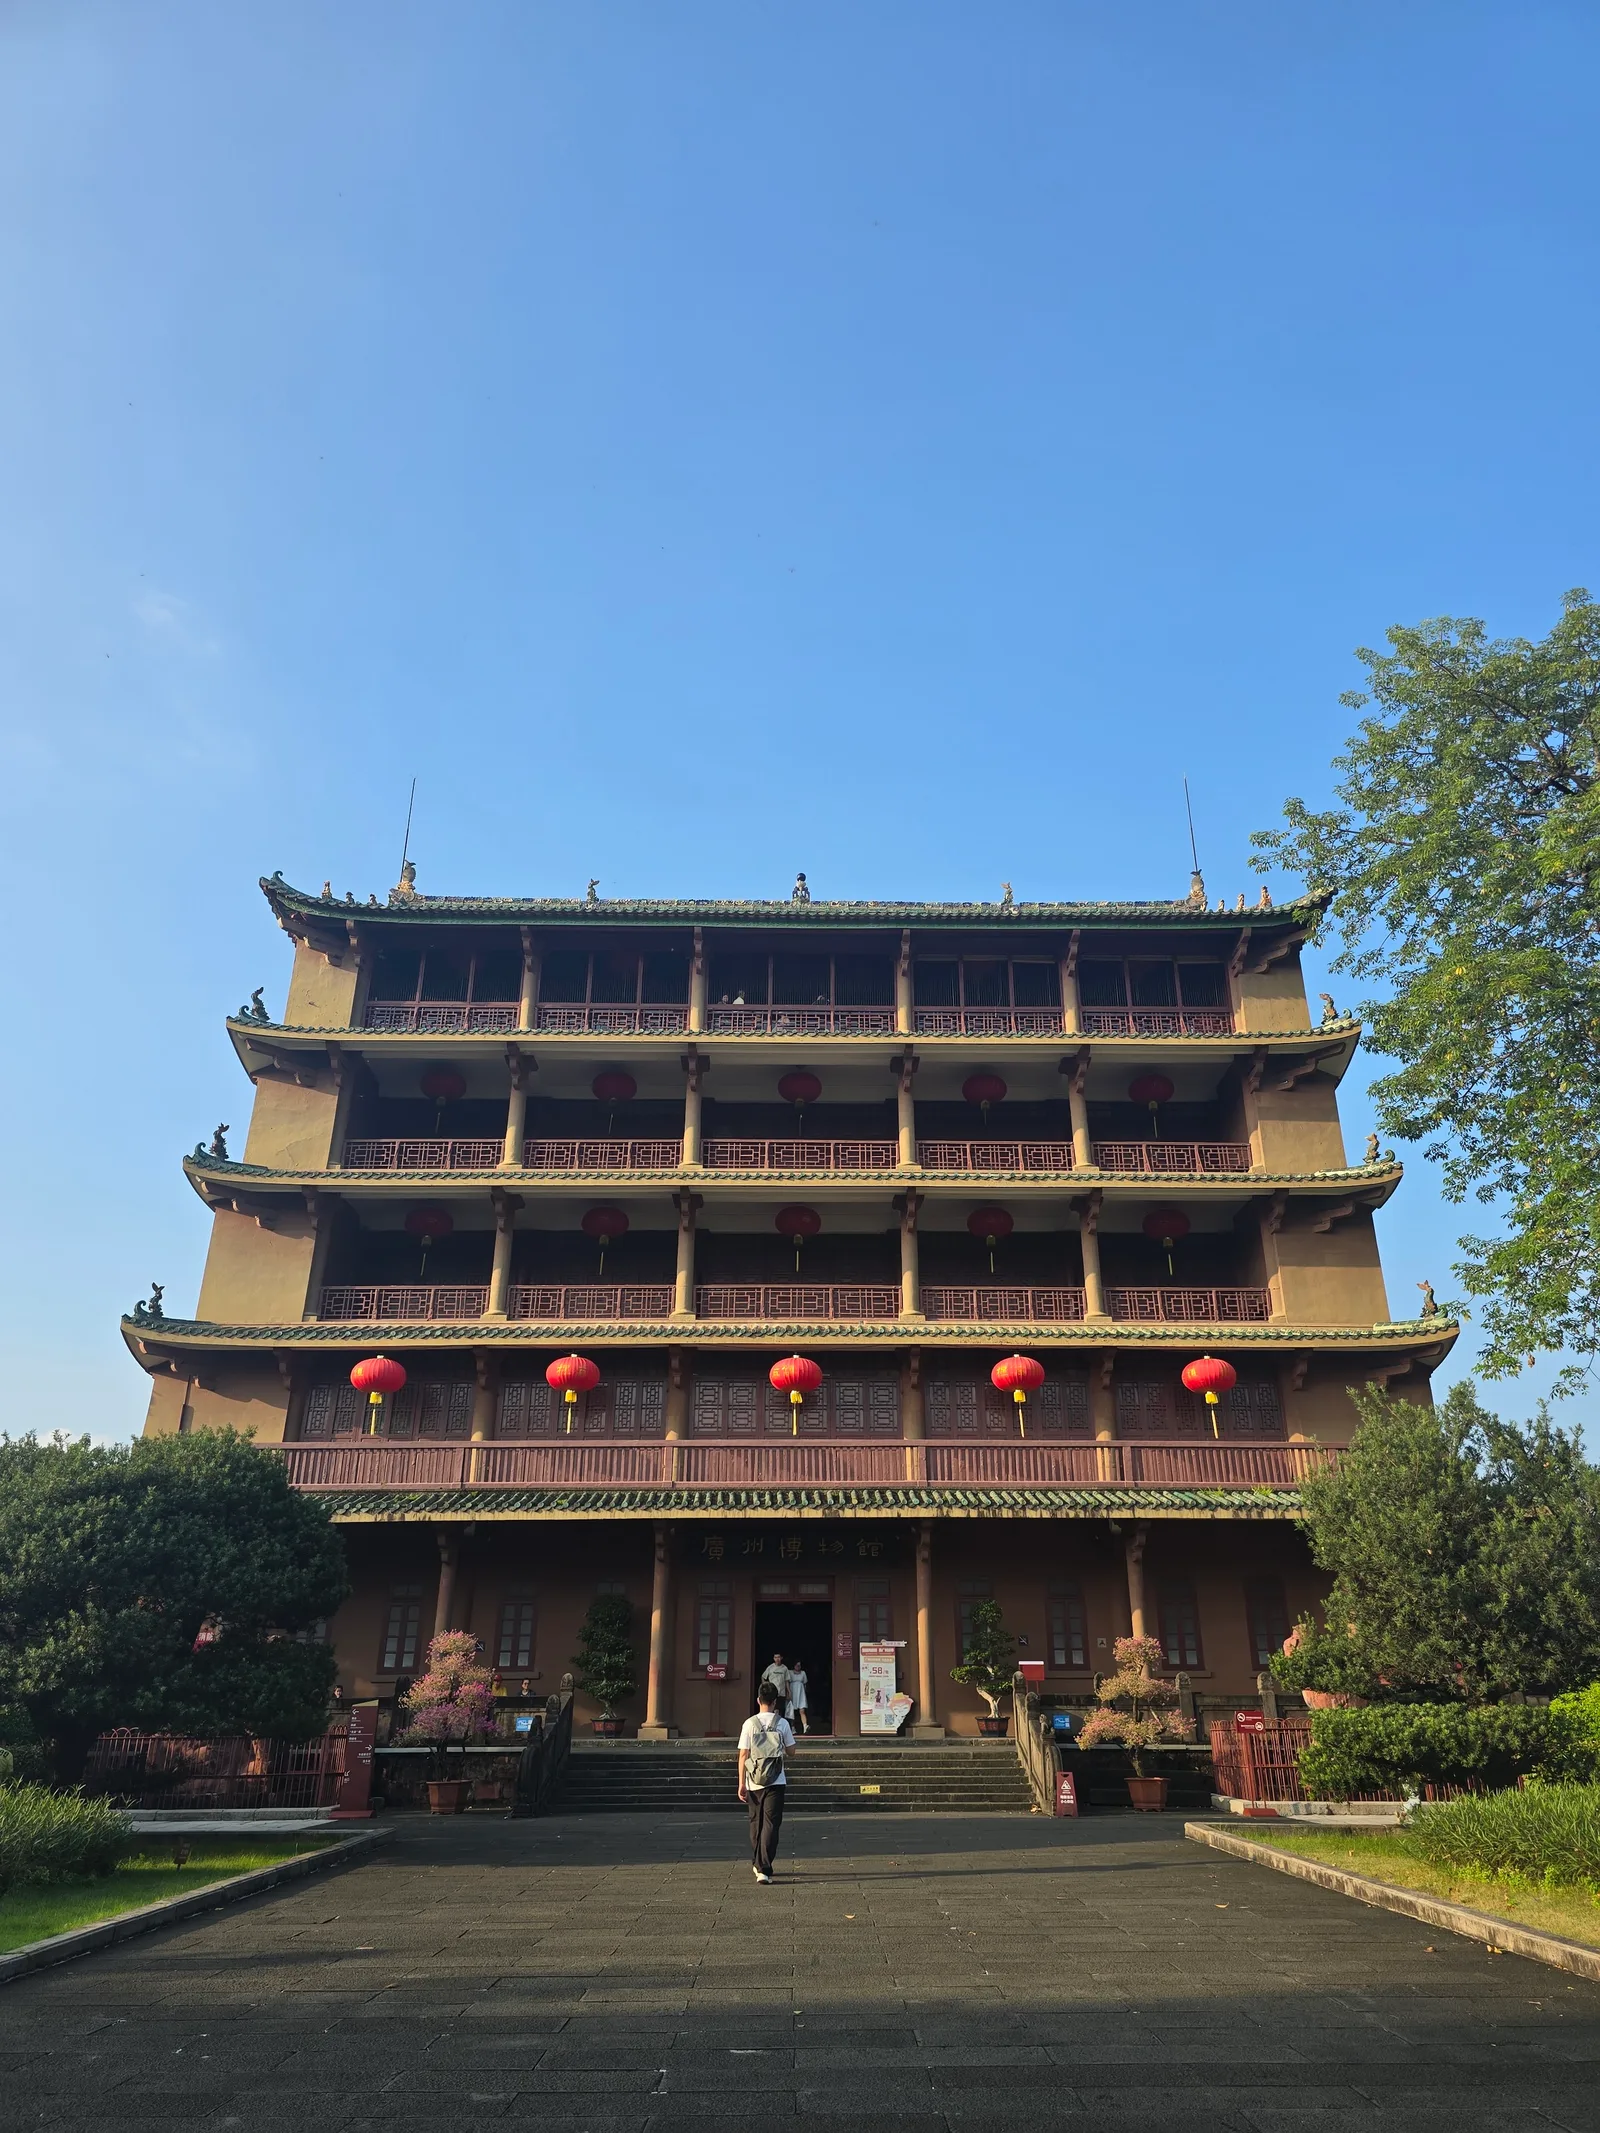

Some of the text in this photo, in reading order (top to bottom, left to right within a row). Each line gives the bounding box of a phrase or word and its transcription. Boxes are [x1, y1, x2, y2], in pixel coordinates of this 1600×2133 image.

[701, 1535, 884, 1560] 廣州博物館
